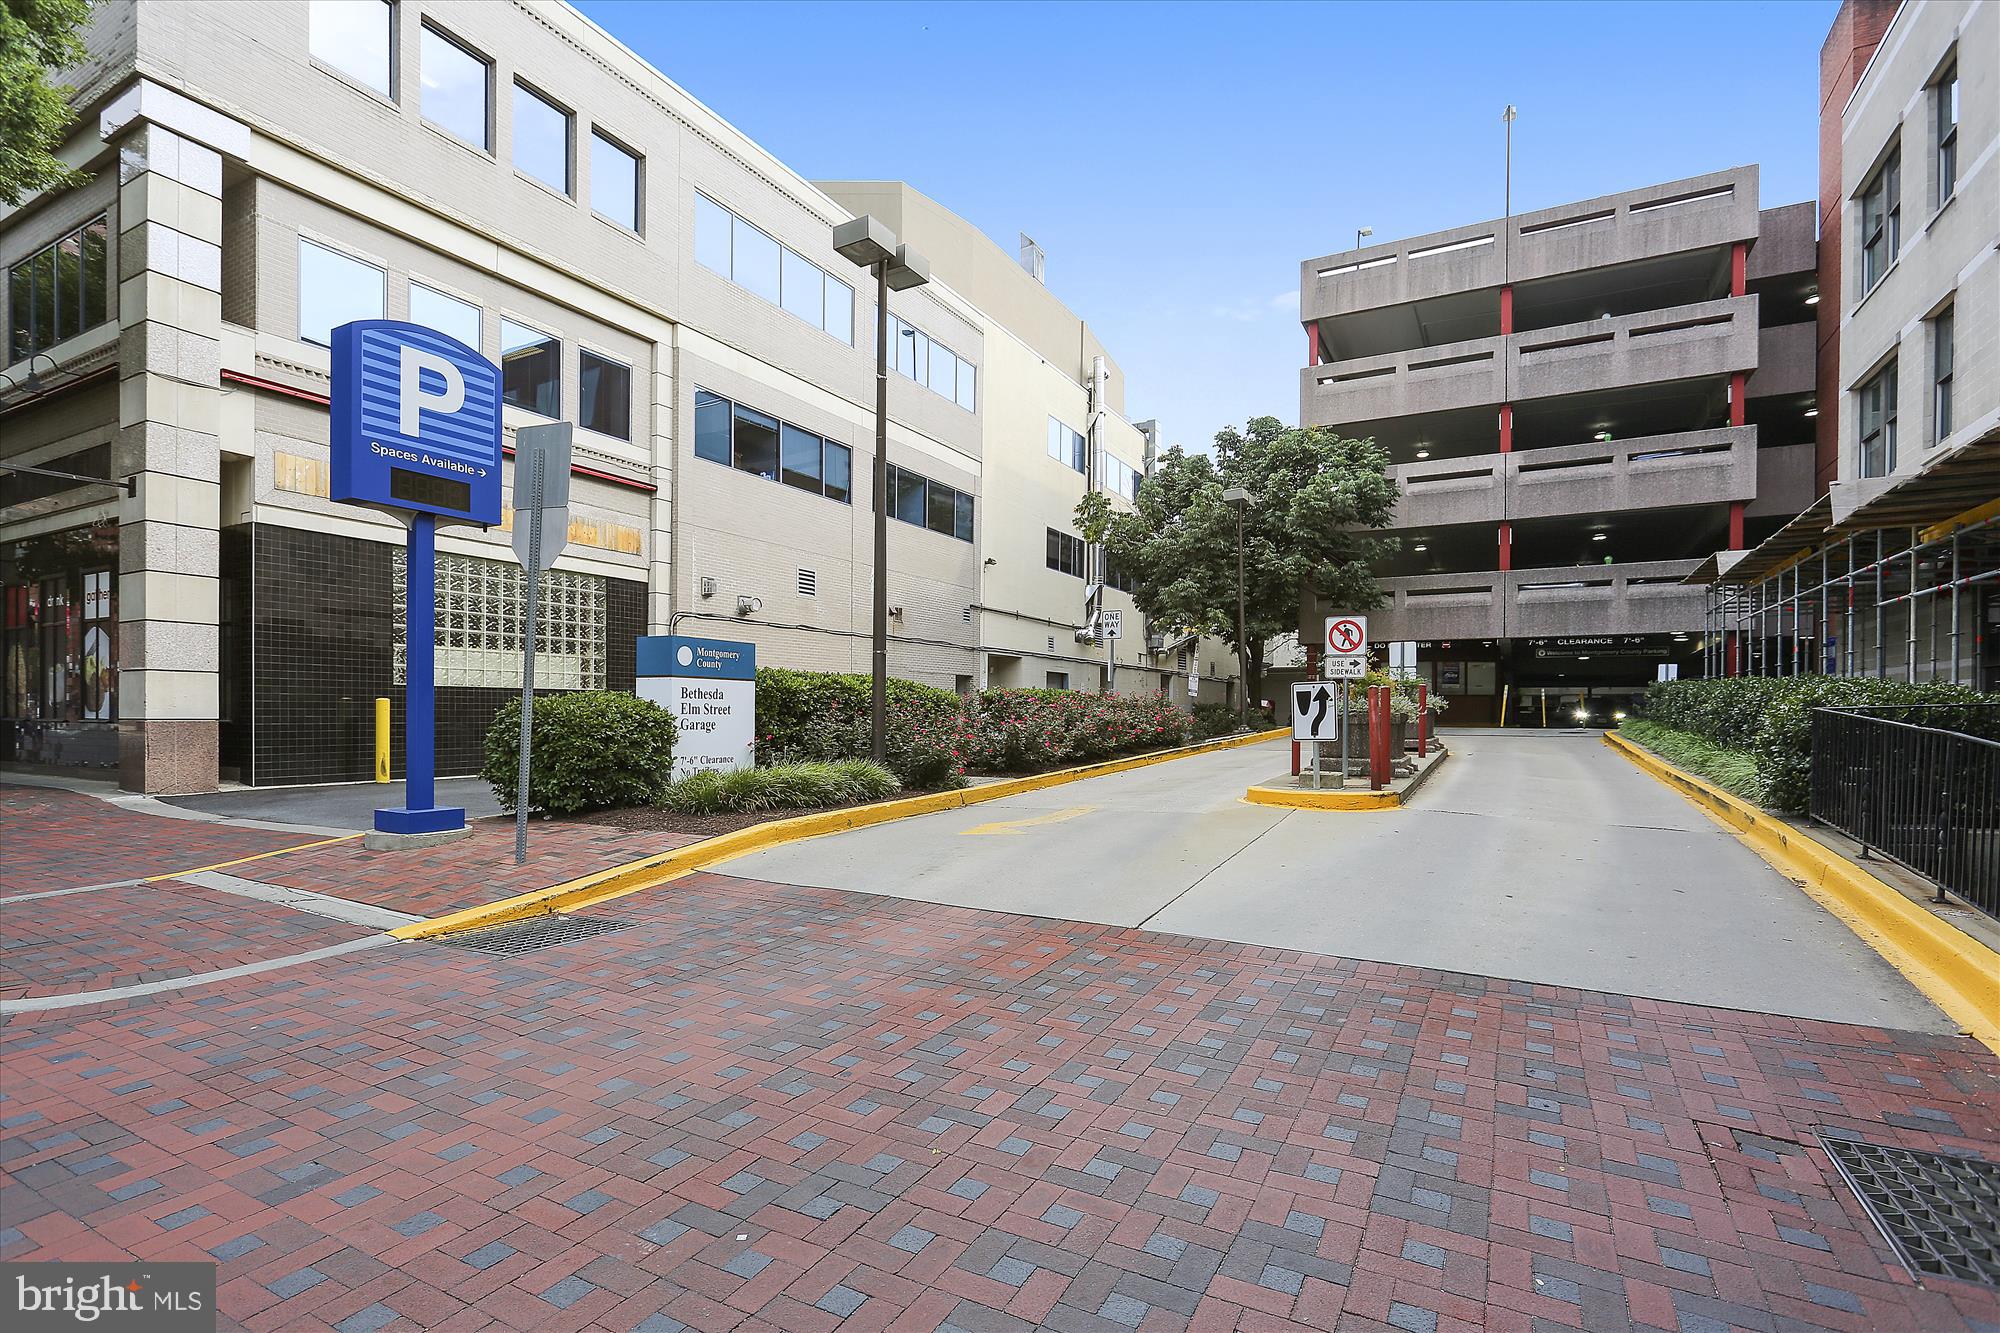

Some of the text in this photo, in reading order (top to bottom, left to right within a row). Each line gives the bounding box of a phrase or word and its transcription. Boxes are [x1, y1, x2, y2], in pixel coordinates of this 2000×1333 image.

[400, 344, 466, 438] P
[371, 441, 475, 475] Spaces Available
[47, 594, 64, 607] drnk
[86, 588, 110, 605] gaher
[1557, 637, 1613, 646] CLEARANCE
[697, 646, 740, 661] Montgomery
[697, 658, 722, 670] County
[680, 686, 724, 700] Bethesda
[680, 702, 731, 716] Elm Street
[680, 718, 716, 733] Garage
[680, 755, 734, 765] 7'-6" Clearance
[680, 768, 691, 776] No
